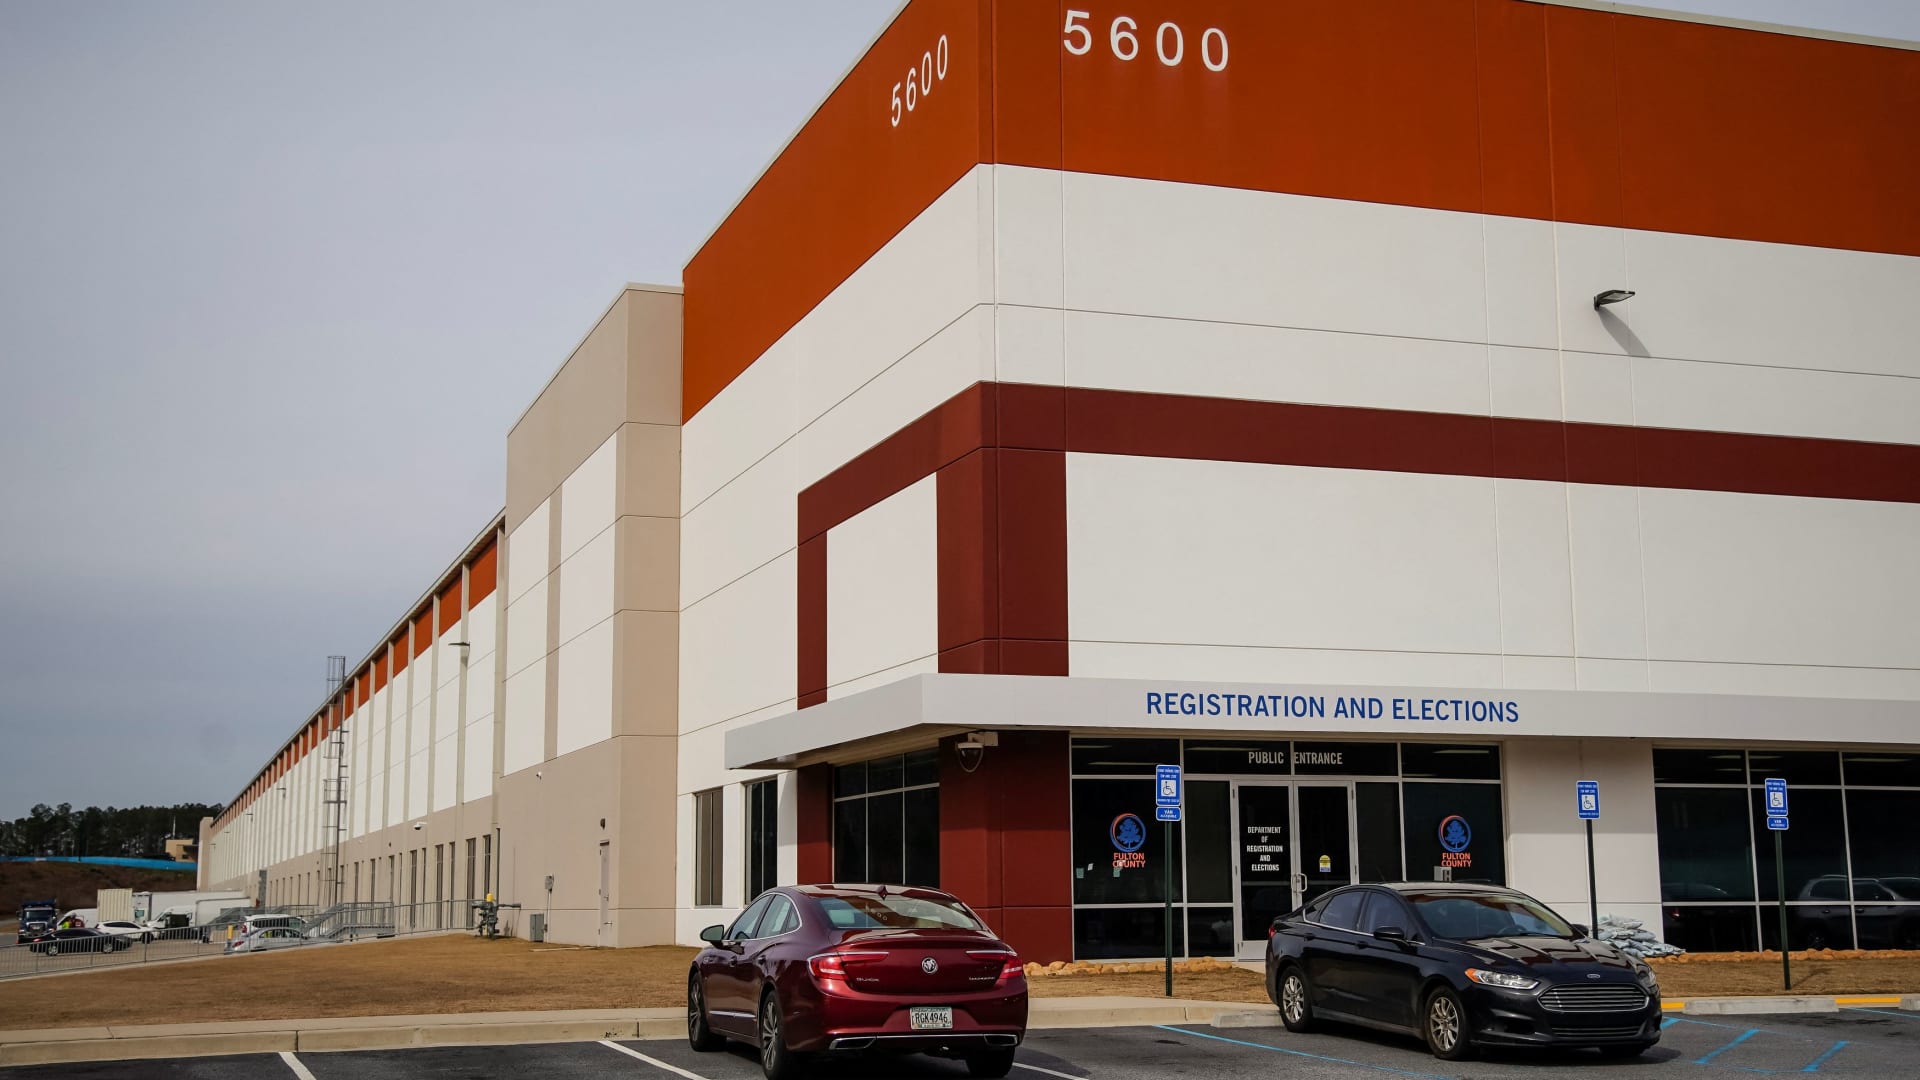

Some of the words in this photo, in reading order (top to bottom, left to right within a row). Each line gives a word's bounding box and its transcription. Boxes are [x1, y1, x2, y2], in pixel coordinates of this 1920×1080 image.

[1063, 9, 1229, 72] 5600
[891, 34, 948, 127] 5600
[1147, 692, 1325, 718] REGISTRATION
[1334, 697, 1383, 719] AND
[1392, 698, 1519, 723] ELECTIONS
[1248, 751, 1284, 764] PUBLIC
[1293, 751, 1343, 765] ENTRANCE
[1247, 826, 1281, 834] DEPARTMENT
[1246, 845, 1284, 853] REGISTRATION
[1113, 852, 1145, 860] FULTON
[1259, 854, 1271, 862] AND
[1442, 852, 1471, 860] FULTON
[1251, 863, 1280, 872] ELECTIONS
[1441, 860, 1472, 868] COUNTY
